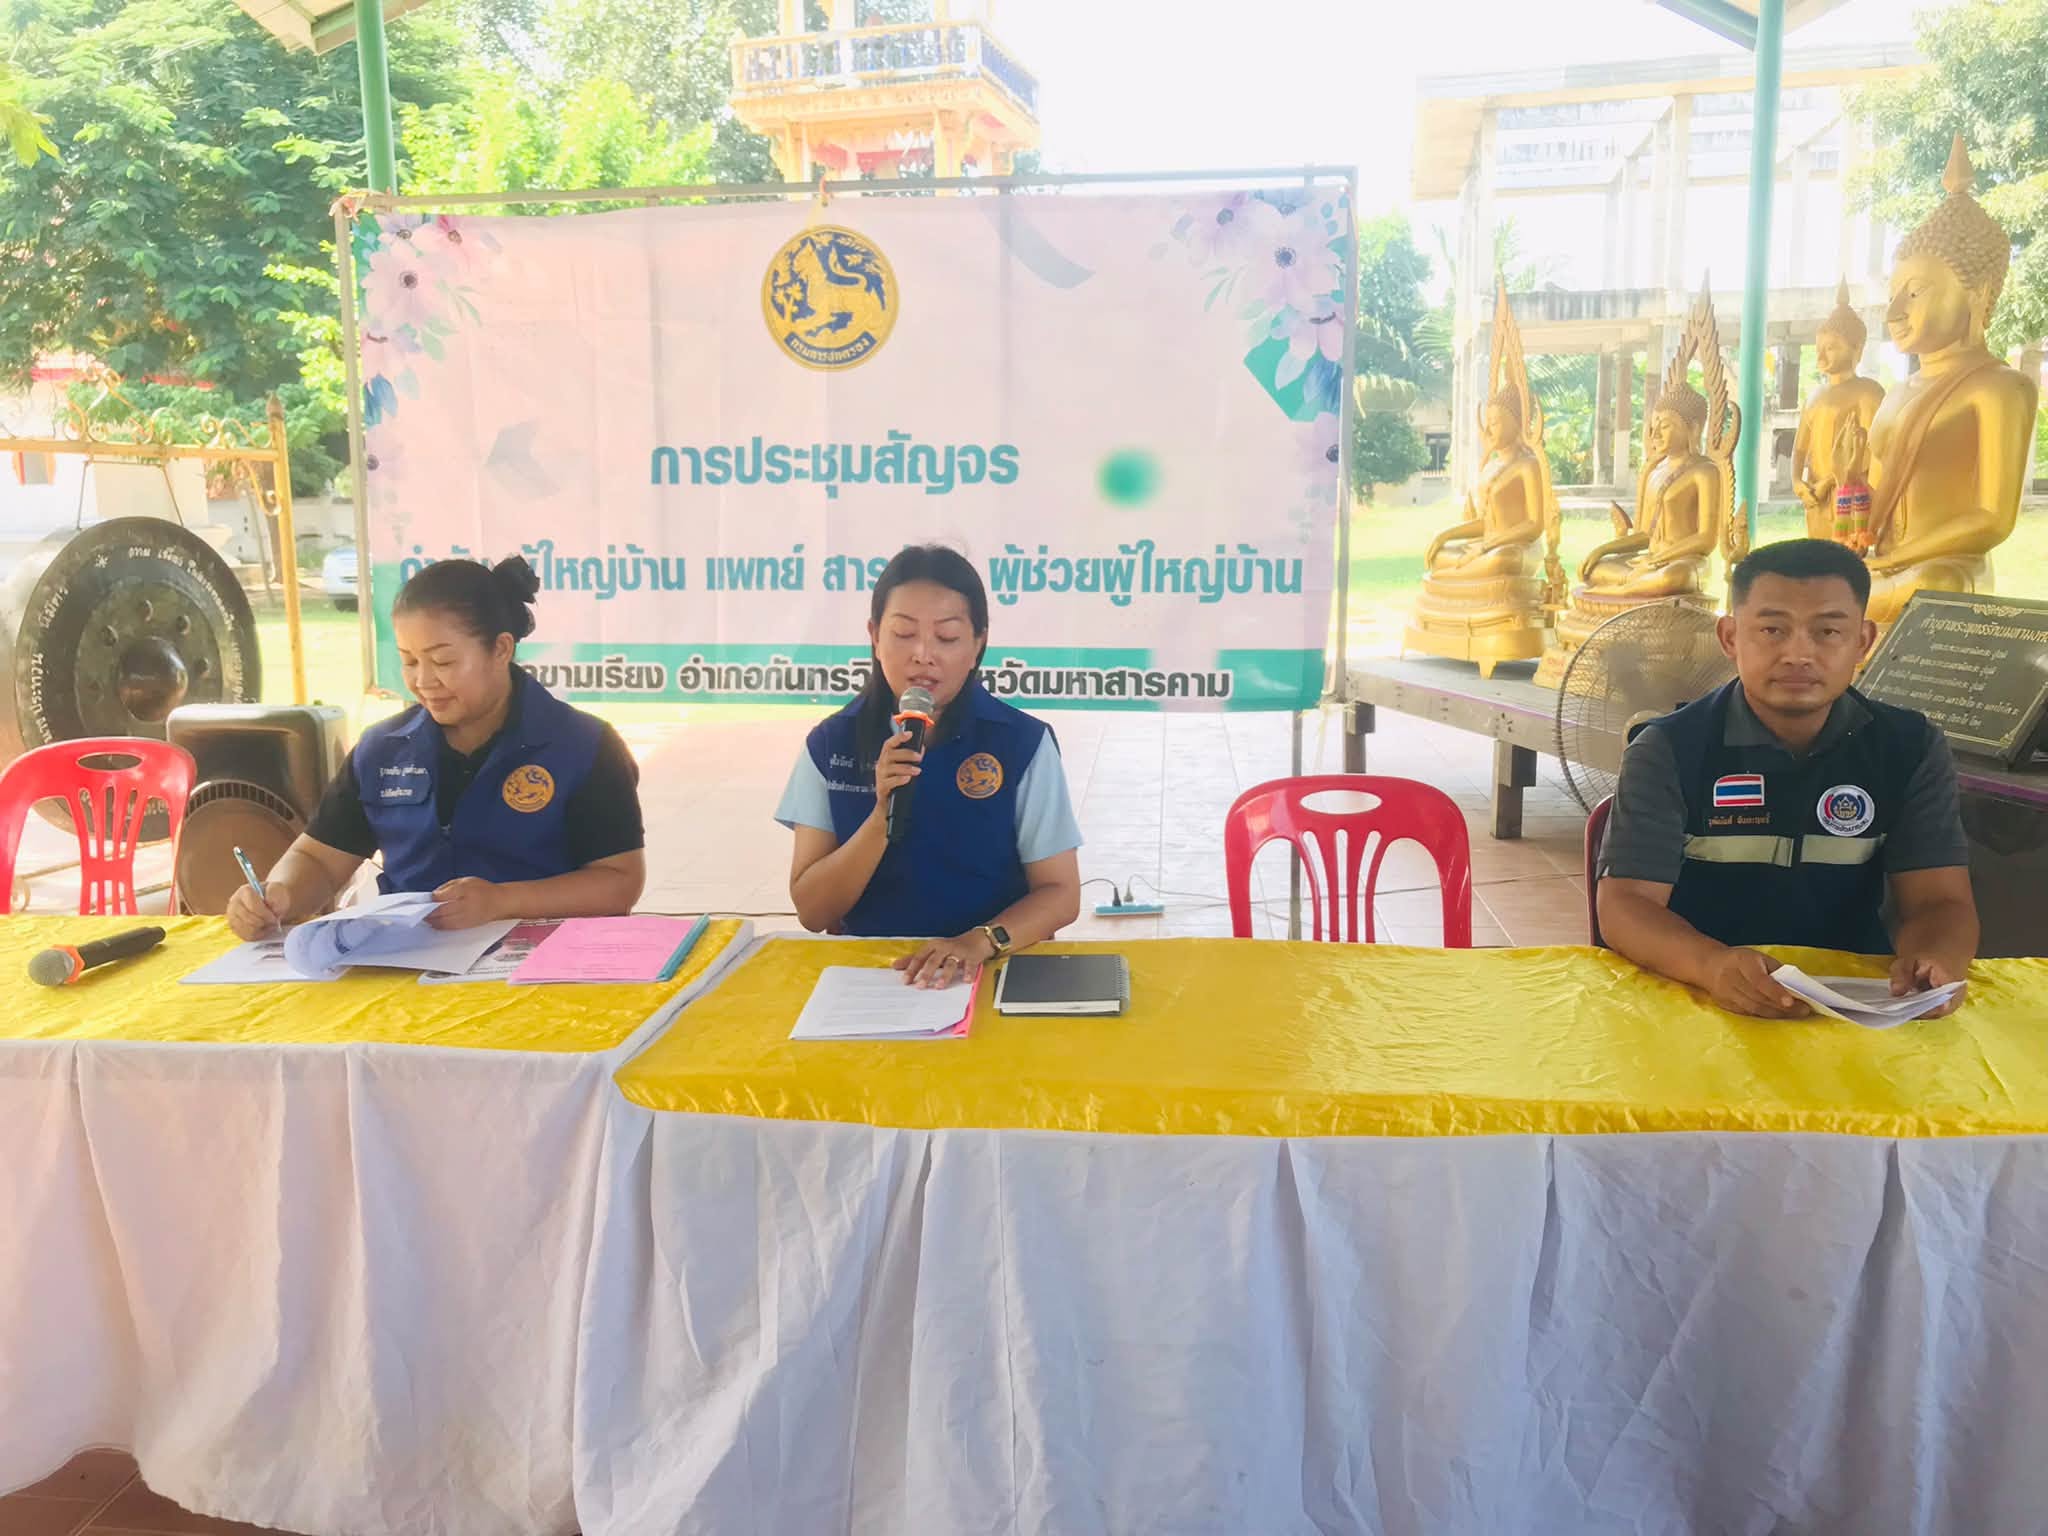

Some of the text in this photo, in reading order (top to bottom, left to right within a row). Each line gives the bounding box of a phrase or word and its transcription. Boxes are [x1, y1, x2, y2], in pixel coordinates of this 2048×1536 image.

[651, 430, 1020, 499] การประชุมสัญจร
[706, 544, 805, 591] แพทย์
[988, 539, 1303, 606] ผู้ช่วยผู้ใหญ่บ้าน
[681, 656, 872, 691] อำเภอกันทรวิ
[978, 660, 1230, 697] หวัดมหาสารคาม
